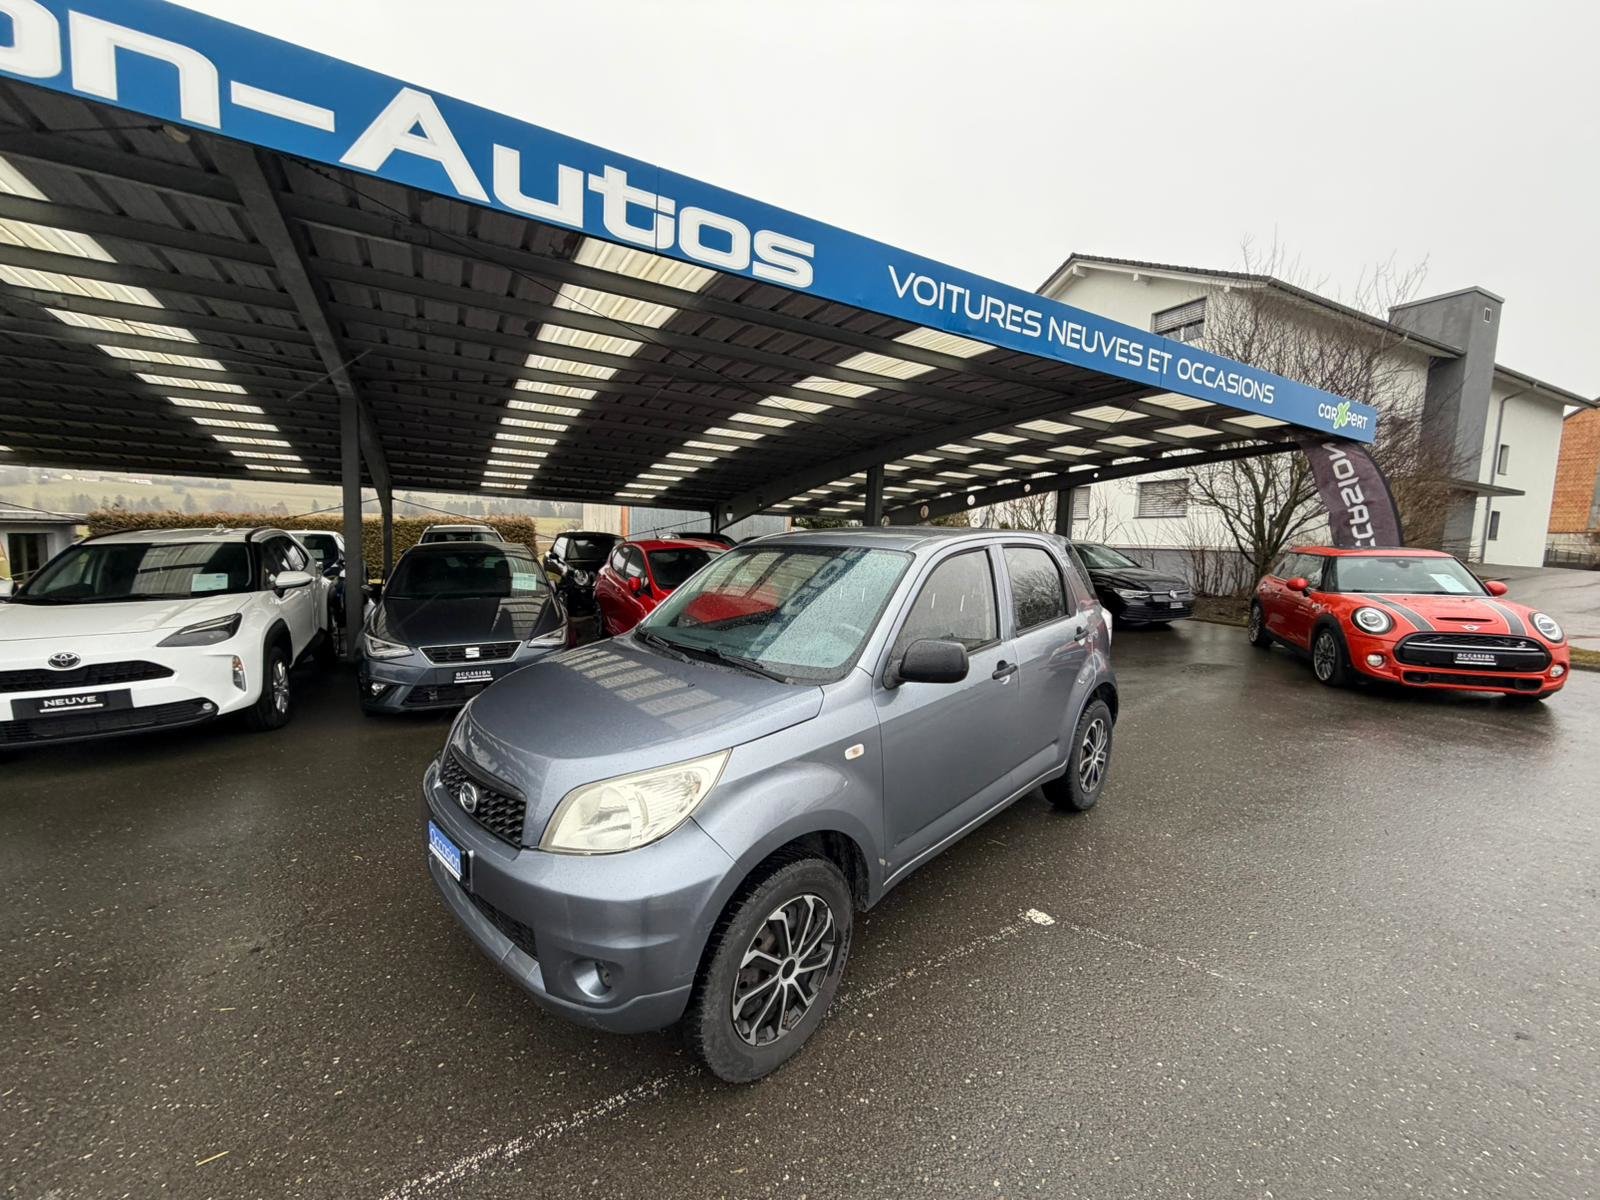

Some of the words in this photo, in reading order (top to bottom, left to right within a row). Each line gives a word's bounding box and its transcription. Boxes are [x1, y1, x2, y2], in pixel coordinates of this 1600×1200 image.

[888, 264, 1043, 338] VOITURES
[1047, 316, 1144, 367] NEUVES
[1147, 347, 1173, 374] ET
[1176, 357, 1275, 404] OCCASIONS
[43, 695, 97, 707] NEUVE
[430, 828, 461, 875] Occasion
